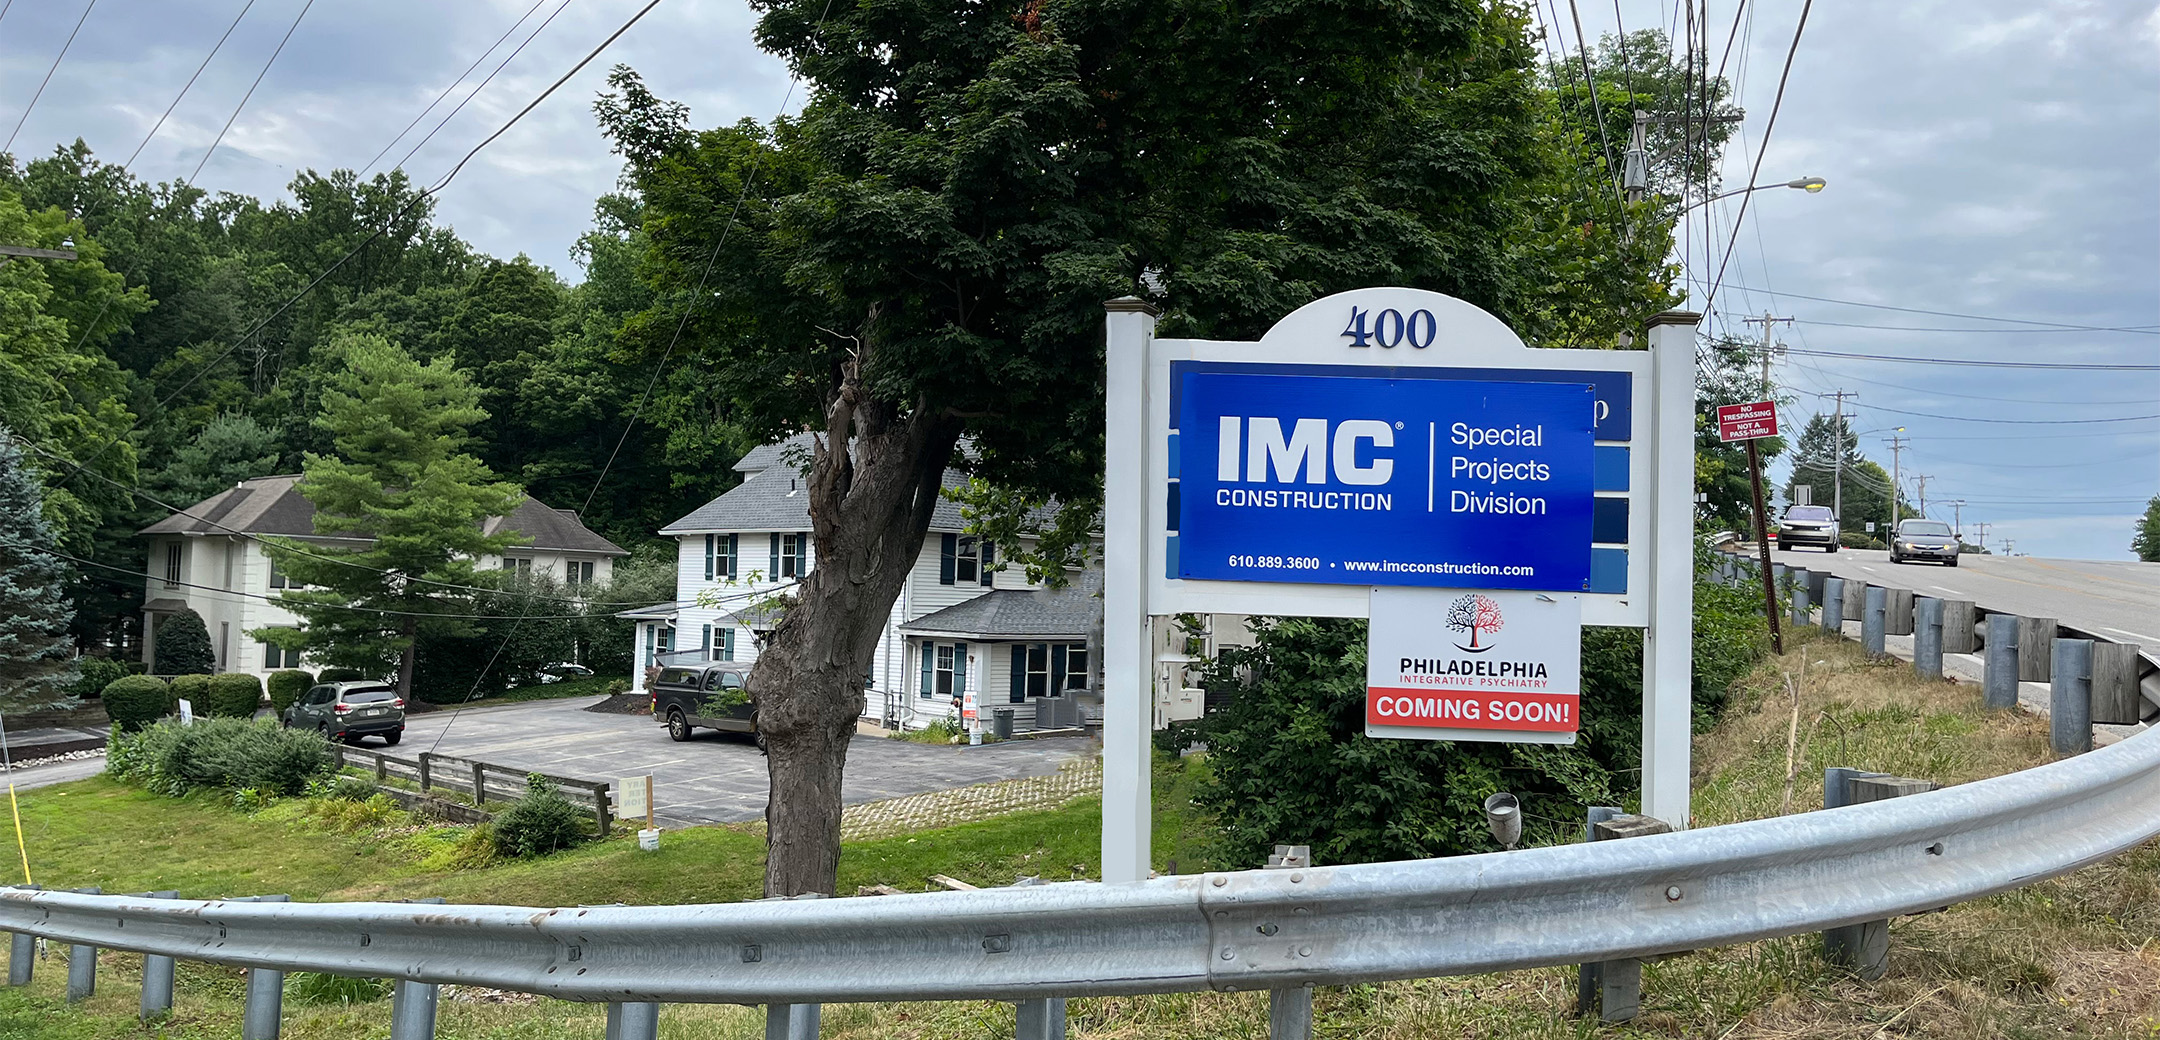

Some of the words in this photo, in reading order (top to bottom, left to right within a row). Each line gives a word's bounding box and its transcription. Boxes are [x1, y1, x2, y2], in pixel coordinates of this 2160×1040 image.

[1340, 305, 1437, 349] 400
[1723, 410, 1771, 421] TRESPASSING
[1737, 422, 1753, 430] NOT
[1450, 422, 1542, 450] Special
[1729, 427, 1769, 438] PASS-THRU
[1451, 456, 1550, 485] Projects
[1216, 488, 1392, 511] CONSTRUCTION
[1450, 490, 1546, 515] Division
[1228, 554, 1320, 570] 610.889.3600
[1344, 558, 1534, 577] www.imcconstruction.com
[1400, 657, 1548, 679] PHILADELPHIA
[1399, 675, 1474, 686] INTEGRATIVE
[1480, 677, 1548, 688] PSYCHIATRY
[1376, 696, 1480, 720] COMING
[1488, 700, 1570, 723] SOON!
